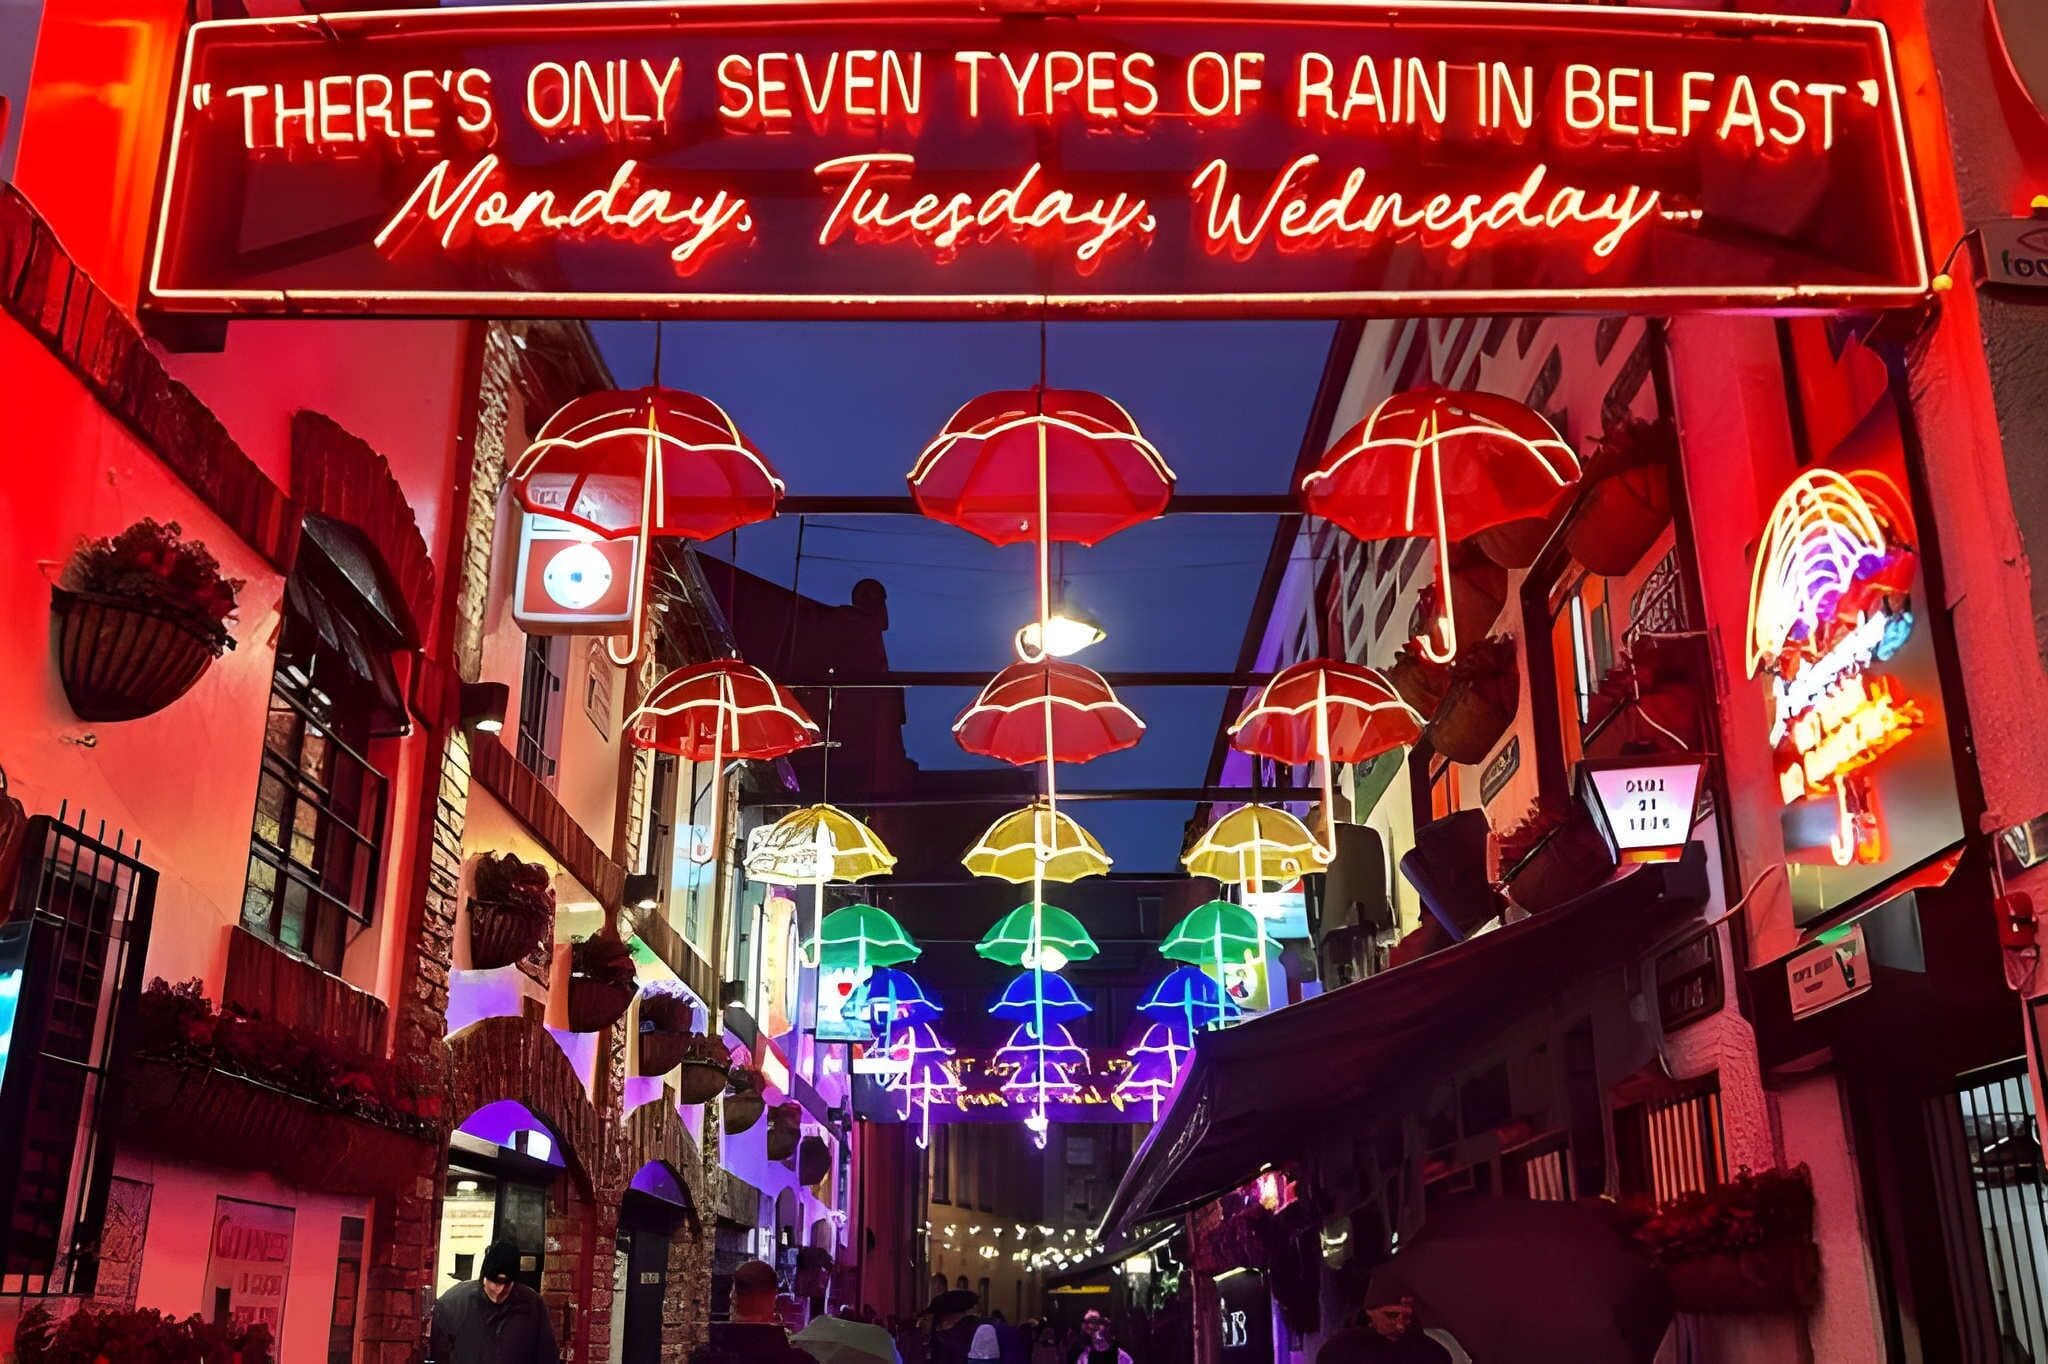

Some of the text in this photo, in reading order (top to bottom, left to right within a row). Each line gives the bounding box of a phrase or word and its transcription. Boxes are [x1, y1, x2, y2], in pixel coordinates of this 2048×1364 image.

[527, 53, 680, 128] ONLY
[717, 49, 922, 118] SEVEN
[954, 50, 1158, 118] TYPES
[1187, 51, 1265, 116] OF
[1297, 52, 1447, 125] RAIN
[1478, 61, 1533, 129] IN
[374, 153, 752, 262] Monday,
[813, 152, 1156, 261] Tuesday,
